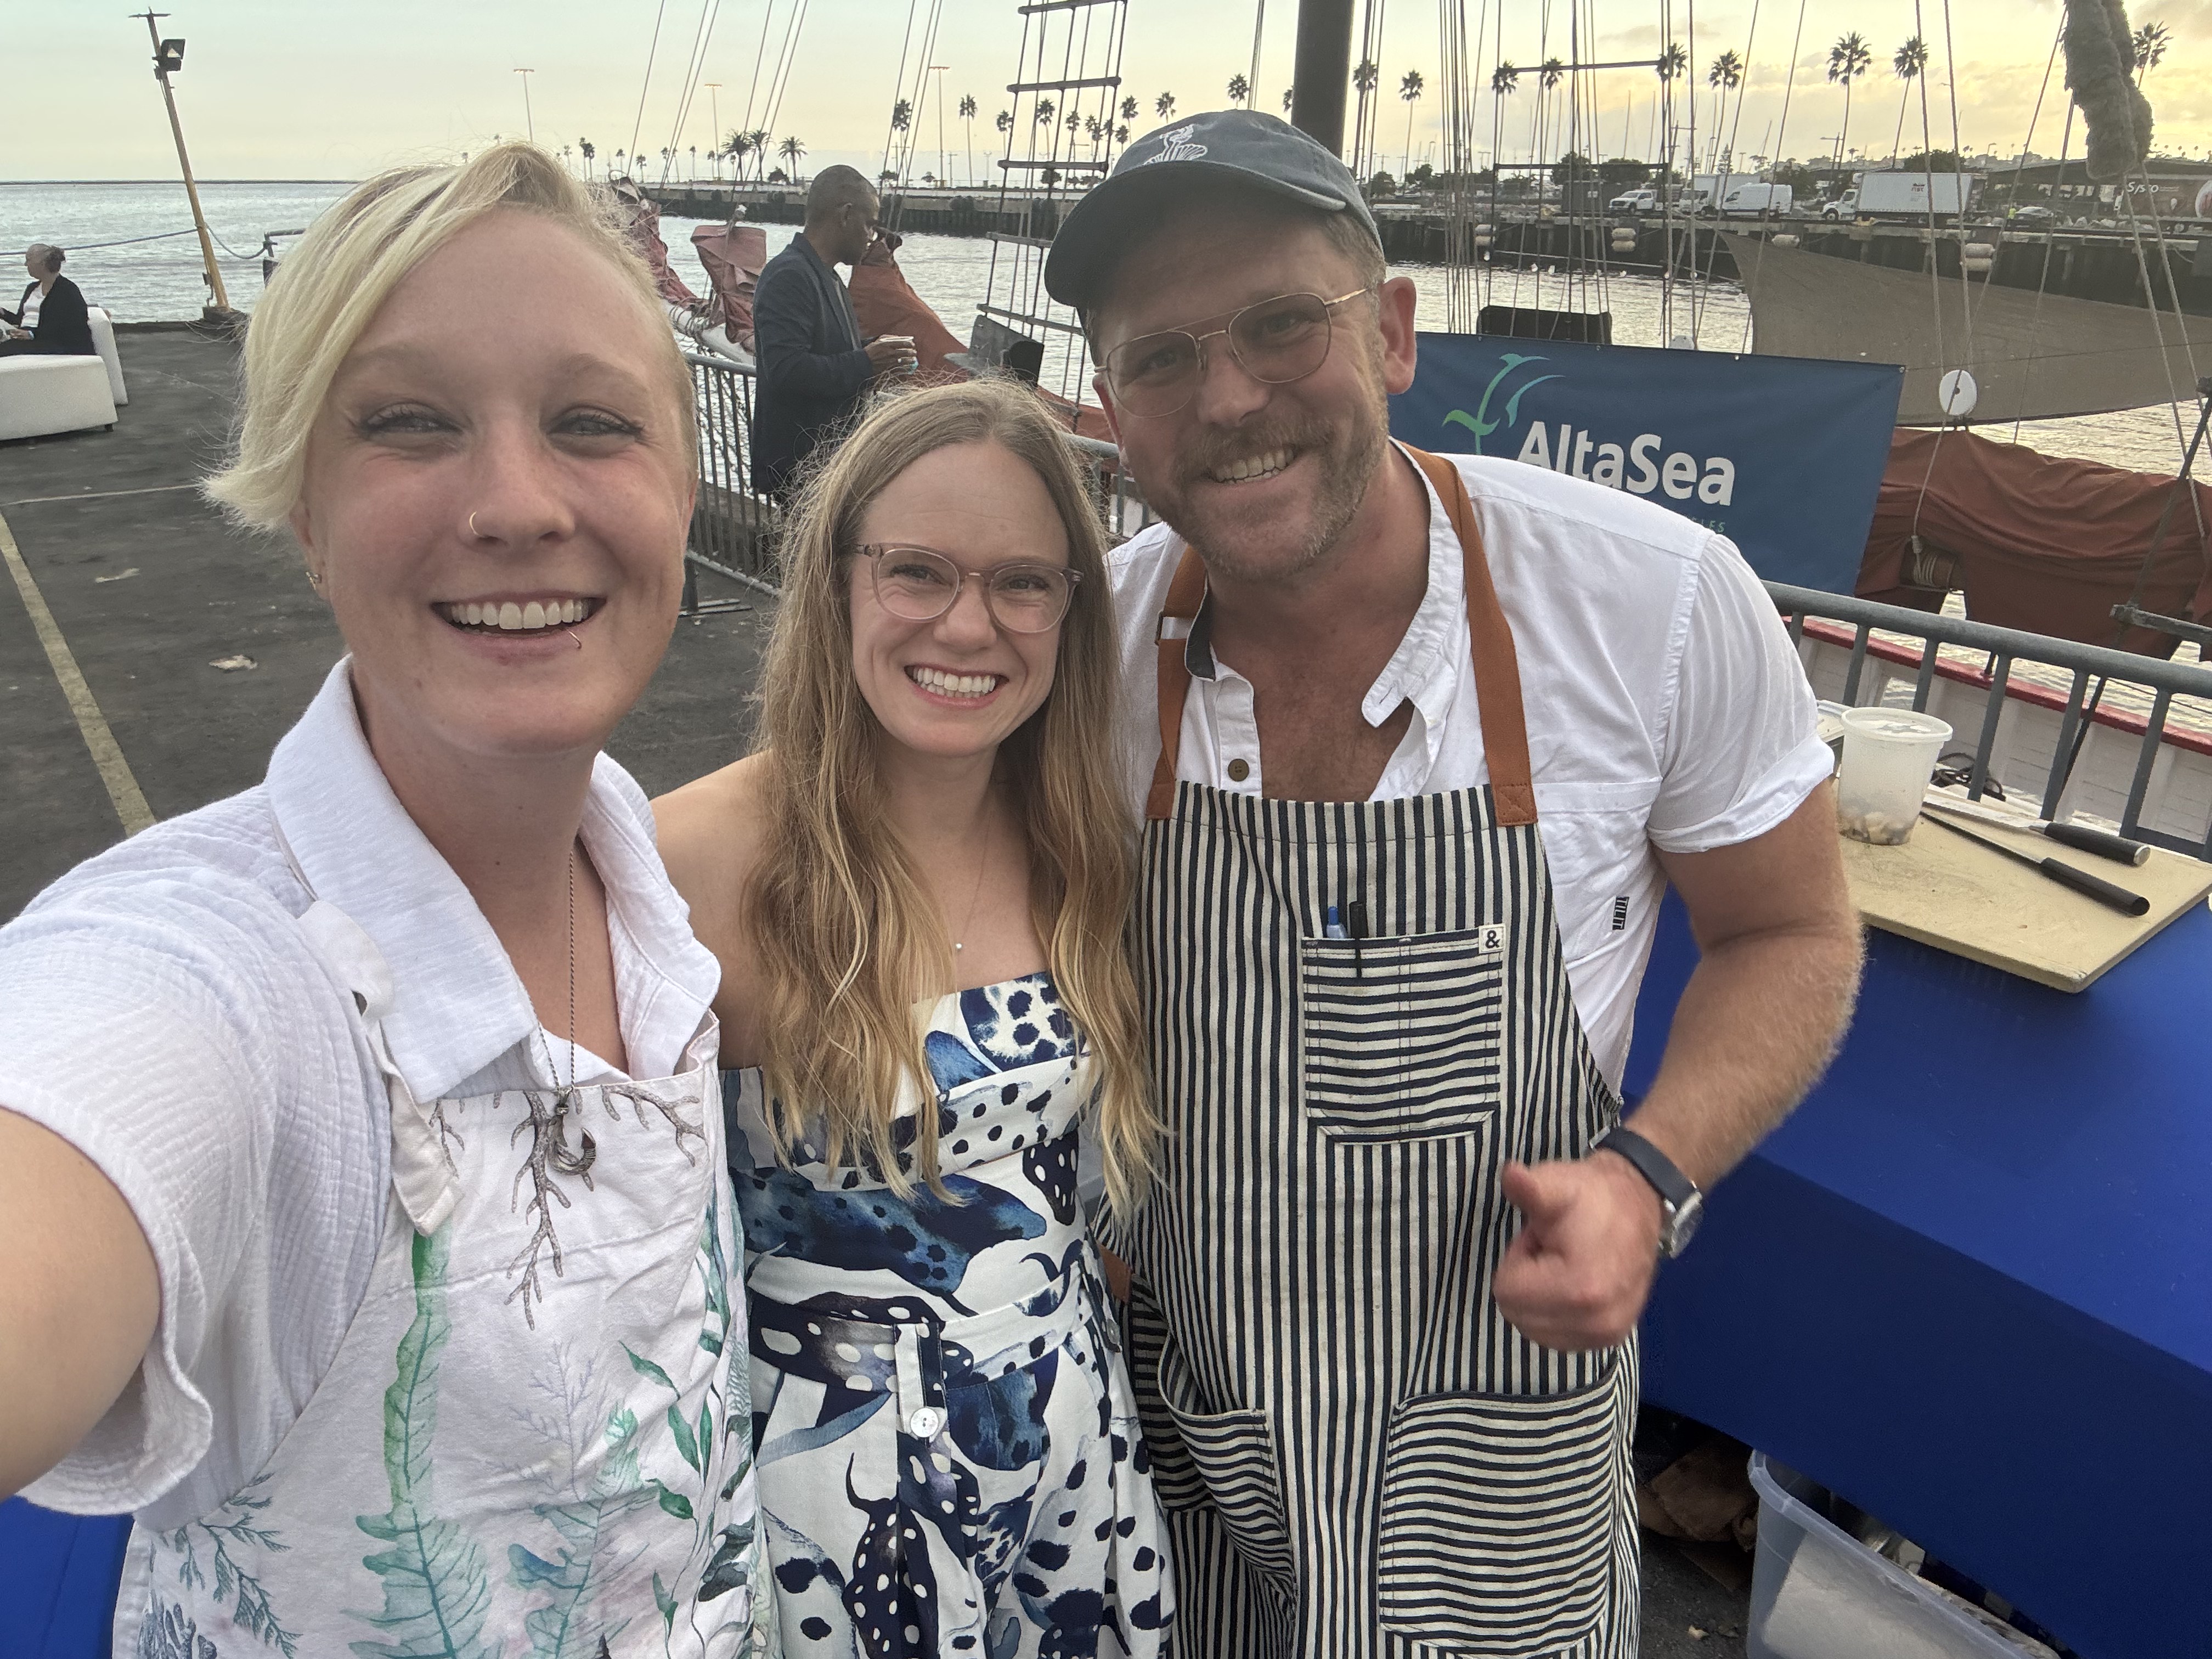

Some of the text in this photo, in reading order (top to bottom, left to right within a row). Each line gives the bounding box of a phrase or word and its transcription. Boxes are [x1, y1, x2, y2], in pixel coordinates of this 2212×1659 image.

[2126, 181, 2159, 195] Syso
[1517, 421, 1735, 506] AltaSea
[1612, 898, 1629, 929] TILIT
[1485, 930, 1500, 949] &
